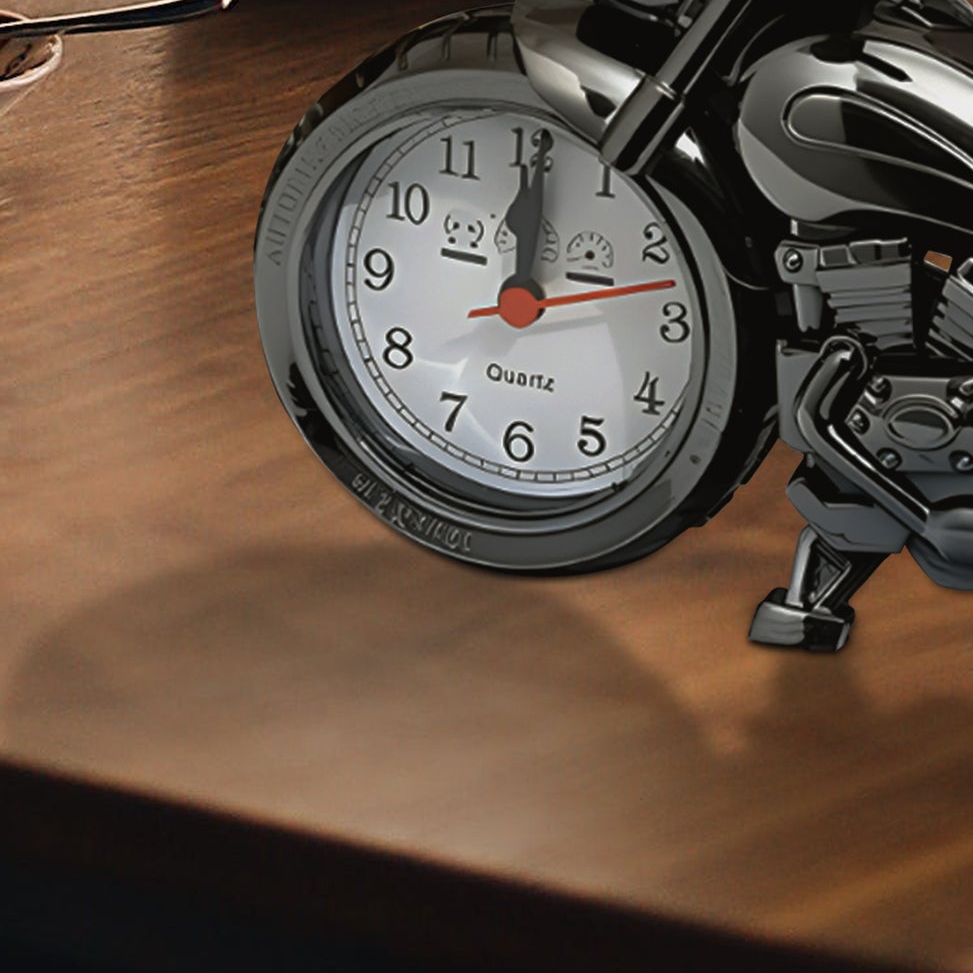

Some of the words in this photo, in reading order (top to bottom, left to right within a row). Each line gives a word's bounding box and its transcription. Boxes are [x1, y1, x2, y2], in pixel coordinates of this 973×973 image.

[439, 135, 480, 181] 11
[509, 127, 554, 173] 12
[595, 163, 616, 199] 1
[385, 181, 430, 226] 10
[642, 222, 670, 265] 2
[363, 248, 395, 291] 9
[659, 301, 690, 344] 3
[382, 327, 414, 370] 8
[486, 363, 555, 392] Quartz
[633, 371, 665, 415] 4
[439, 391, 468, 433] 7
[502, 420, 535, 463] 6
[577, 415, 607, 457] 5
